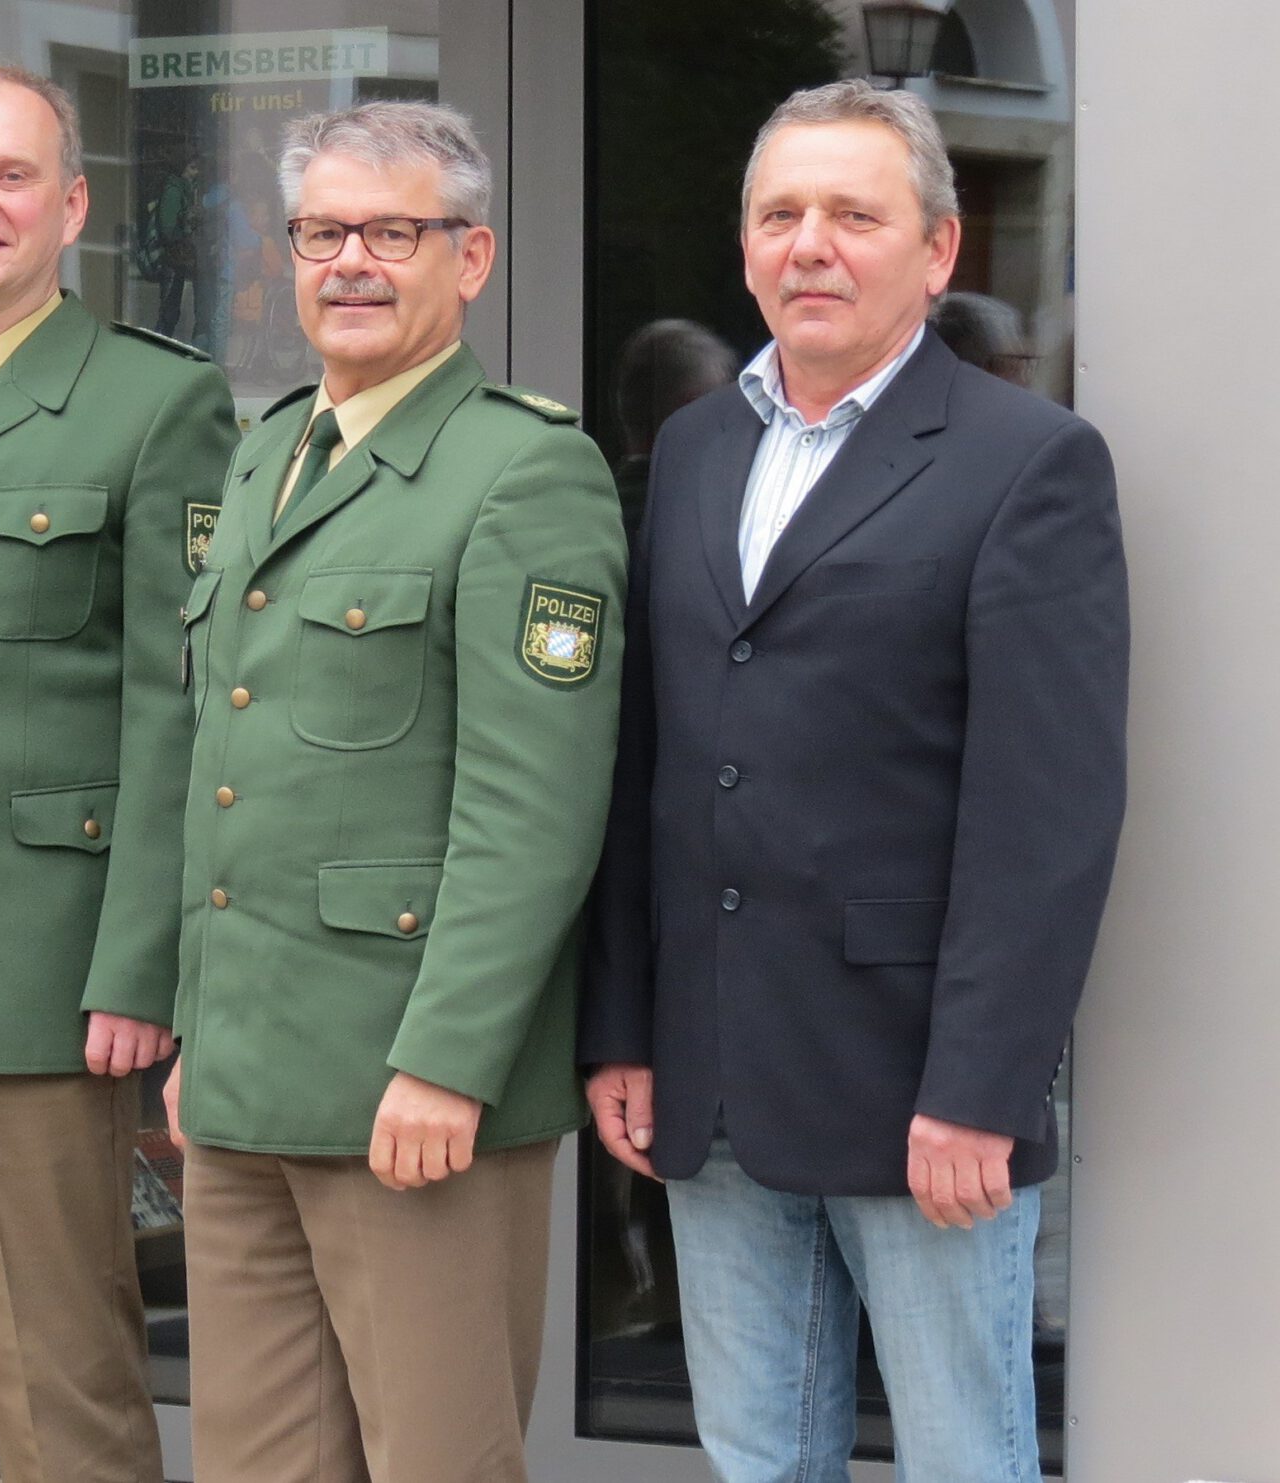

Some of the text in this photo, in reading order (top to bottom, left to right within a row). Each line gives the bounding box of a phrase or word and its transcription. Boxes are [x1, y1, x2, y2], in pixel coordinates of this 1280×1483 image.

[140, 43, 377, 80] BREMSBEREIT
[211, 90, 303, 113] für uns!
[536, 595, 595, 623] POLIZEI
